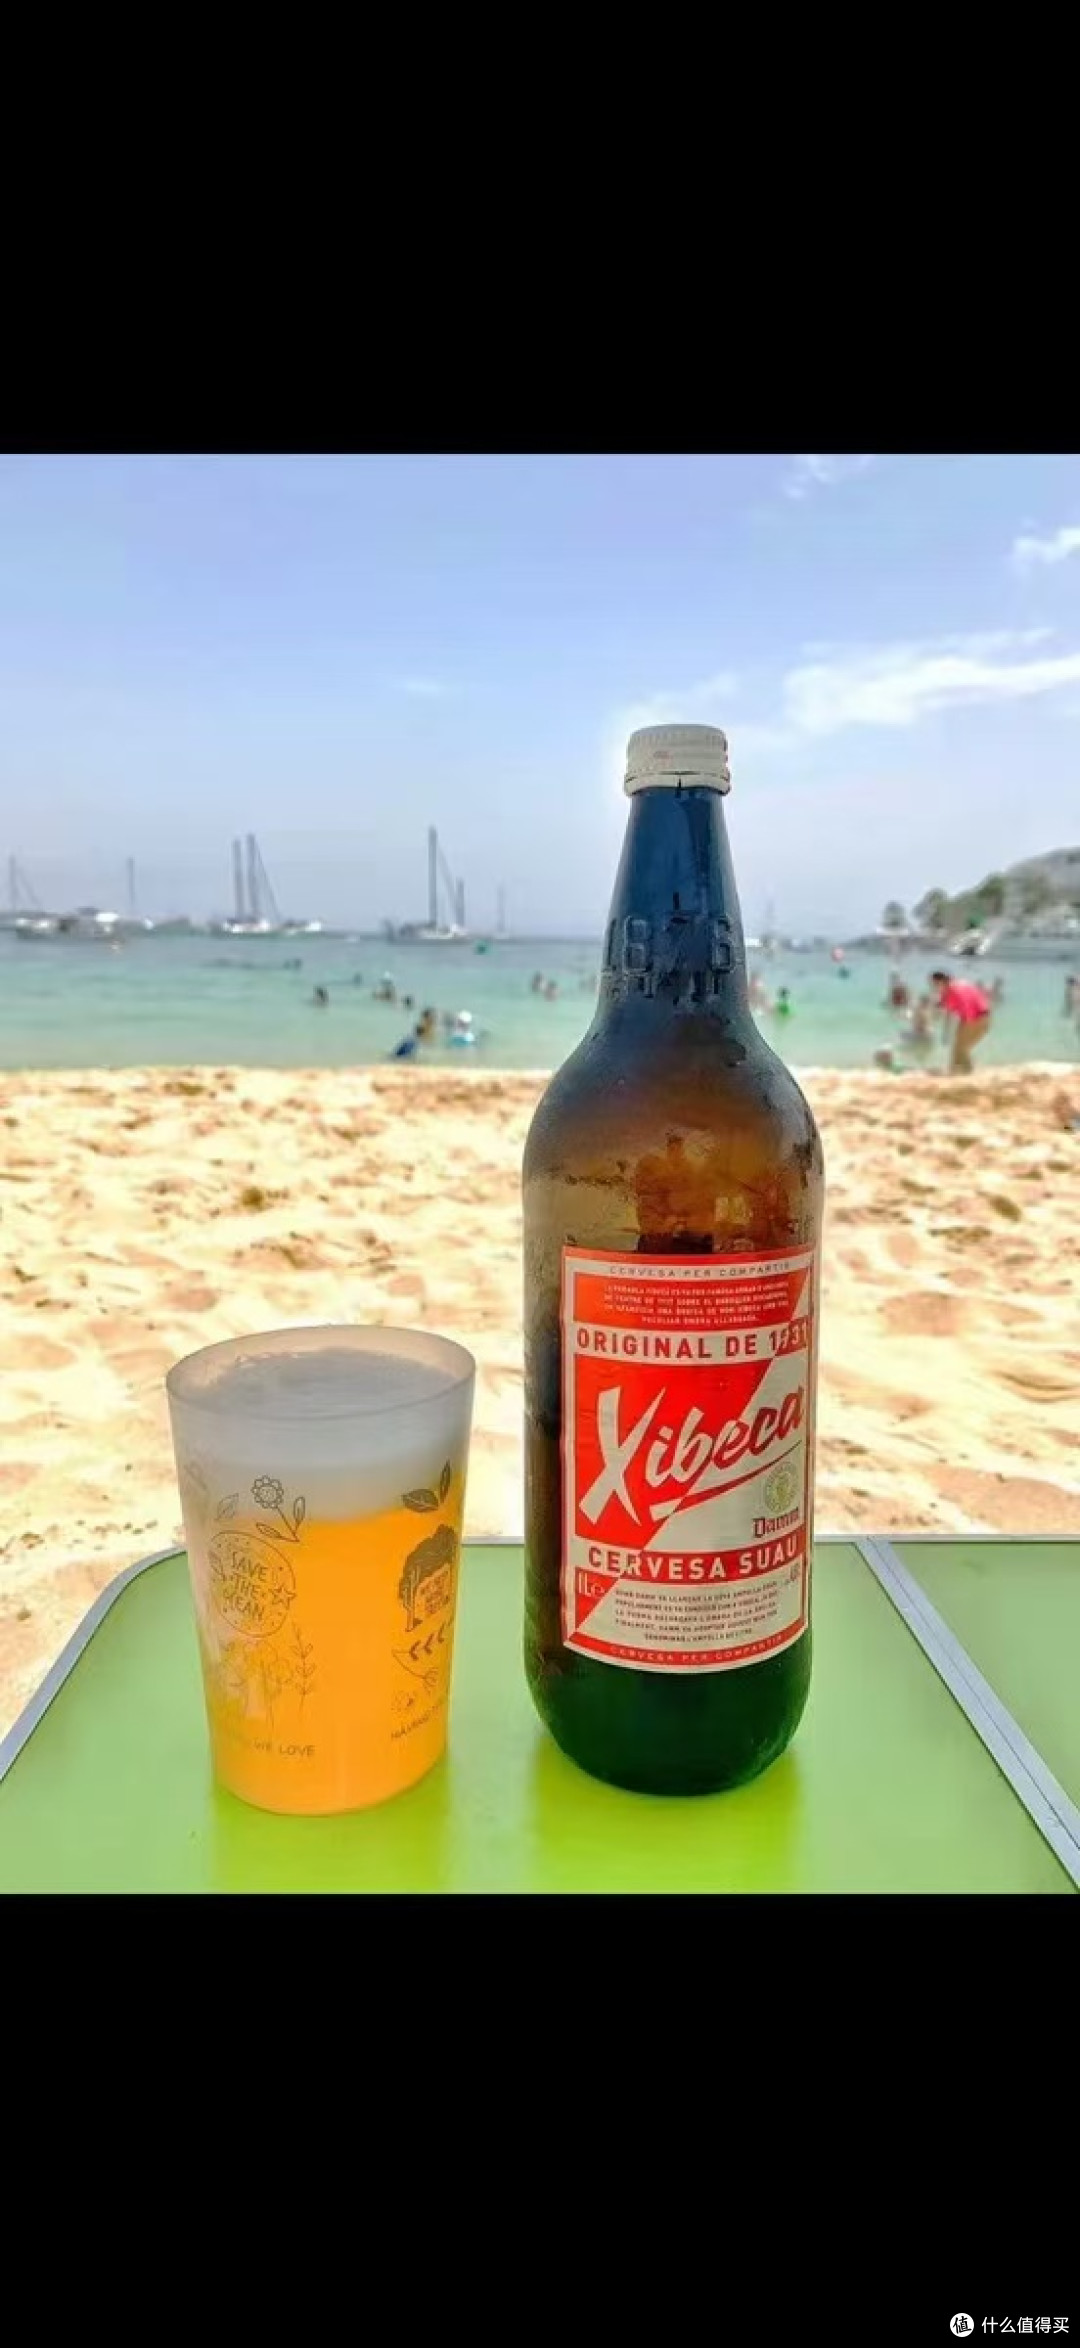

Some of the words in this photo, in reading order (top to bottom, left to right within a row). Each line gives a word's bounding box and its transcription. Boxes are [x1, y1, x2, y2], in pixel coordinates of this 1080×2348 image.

[609, 1266, 676, 1277] CERVESA
[683, 1269, 711, 1277] PER
[719, 1261, 790, 1276] COMPARTIR
[577, 1328, 712, 1358] ORIGINAL
[725, 1334, 757, 1356] DE
[768, 1320, 809, 1352] 1931
[579, 1384, 805, 1527] Xibeca
[752, 1507, 799, 1538] Damm
[588, 1547, 727, 1580] CERVESA
[738, 1541, 799, 1575] SUAU
[233, 1572, 261, 1601] THE
[610, 1645, 674, 1662] CERVESA
[682, 1654, 708, 1662] PER
[279, 1744, 315, 1757] LOVE
